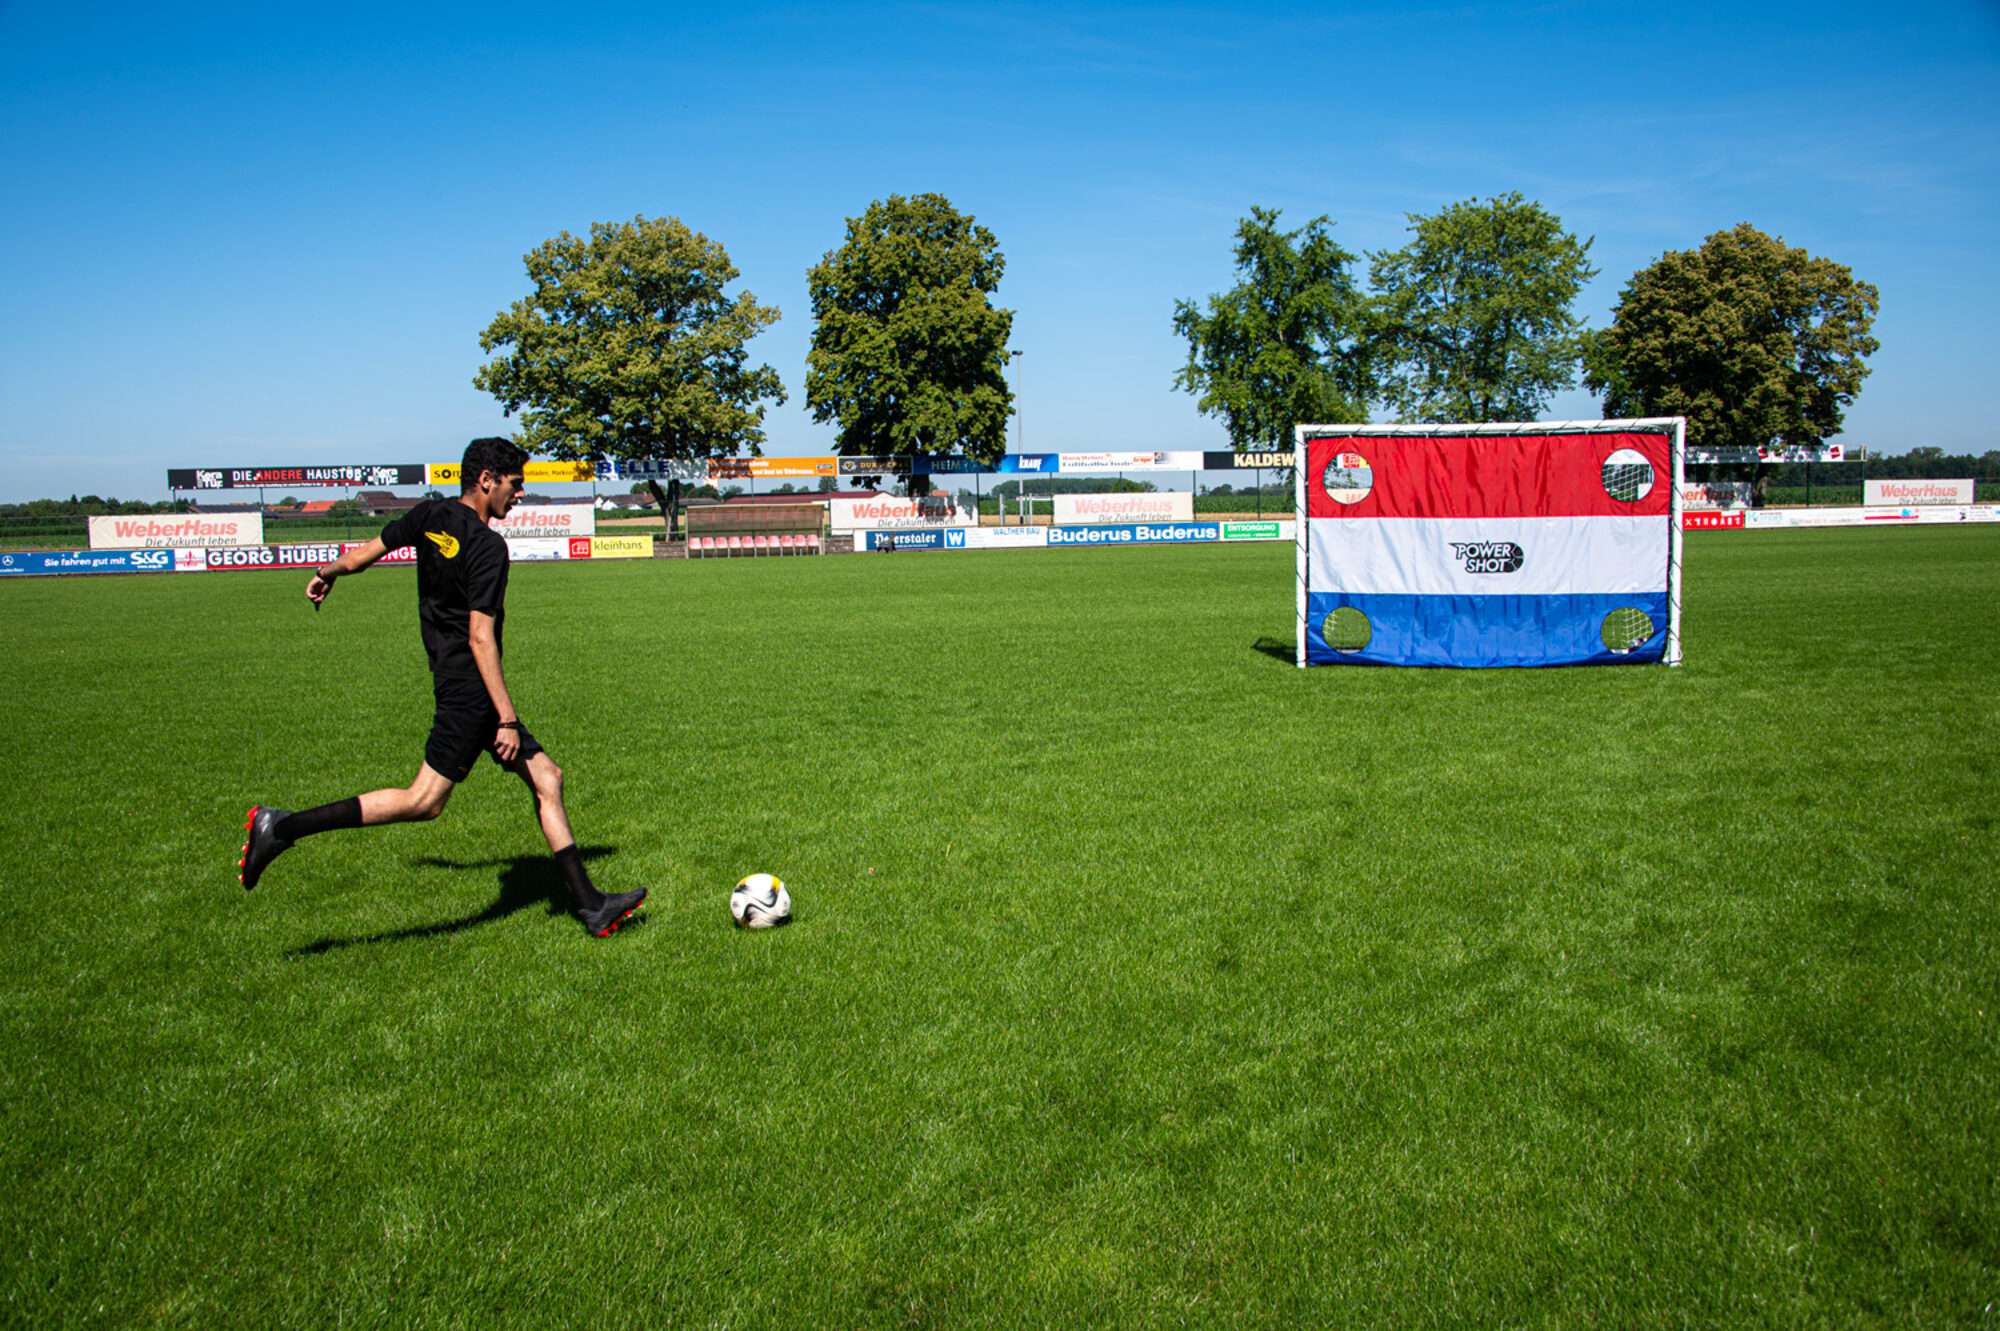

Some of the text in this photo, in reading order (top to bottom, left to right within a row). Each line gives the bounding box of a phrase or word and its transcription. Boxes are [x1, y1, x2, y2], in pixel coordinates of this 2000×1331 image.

[1234, 453, 1296, 468] KALDEW
[232, 470, 252, 481] DIE
[256, 469, 303, 481] ANDERE
[1881, 484, 1958, 498] WeberHaus
[852, 502, 957, 519] WeberHaus
[1073, 498, 1174, 514] WeberHaus
[114, 519, 238, 538] WeberHaus
[504, 527, 570, 538] Zukunft leben
[1048, 525, 1217, 543] Buderus Buderus
[145, 535, 237, 547] Die Zukunft leben
[594, 539, 643, 552] kleinhans
[875, 533, 937, 547] Peerstaler
[947, 532, 964, 545] W
[130, 551, 168, 565] S&G
[207, 551, 274, 566] GEORG
[279, 548, 339, 564] HUBER
[1456, 544, 1512, 558] POWER
[44, 557, 126, 567] Sie fahren gut mit
[1466, 558, 1512, 572] SHOT
